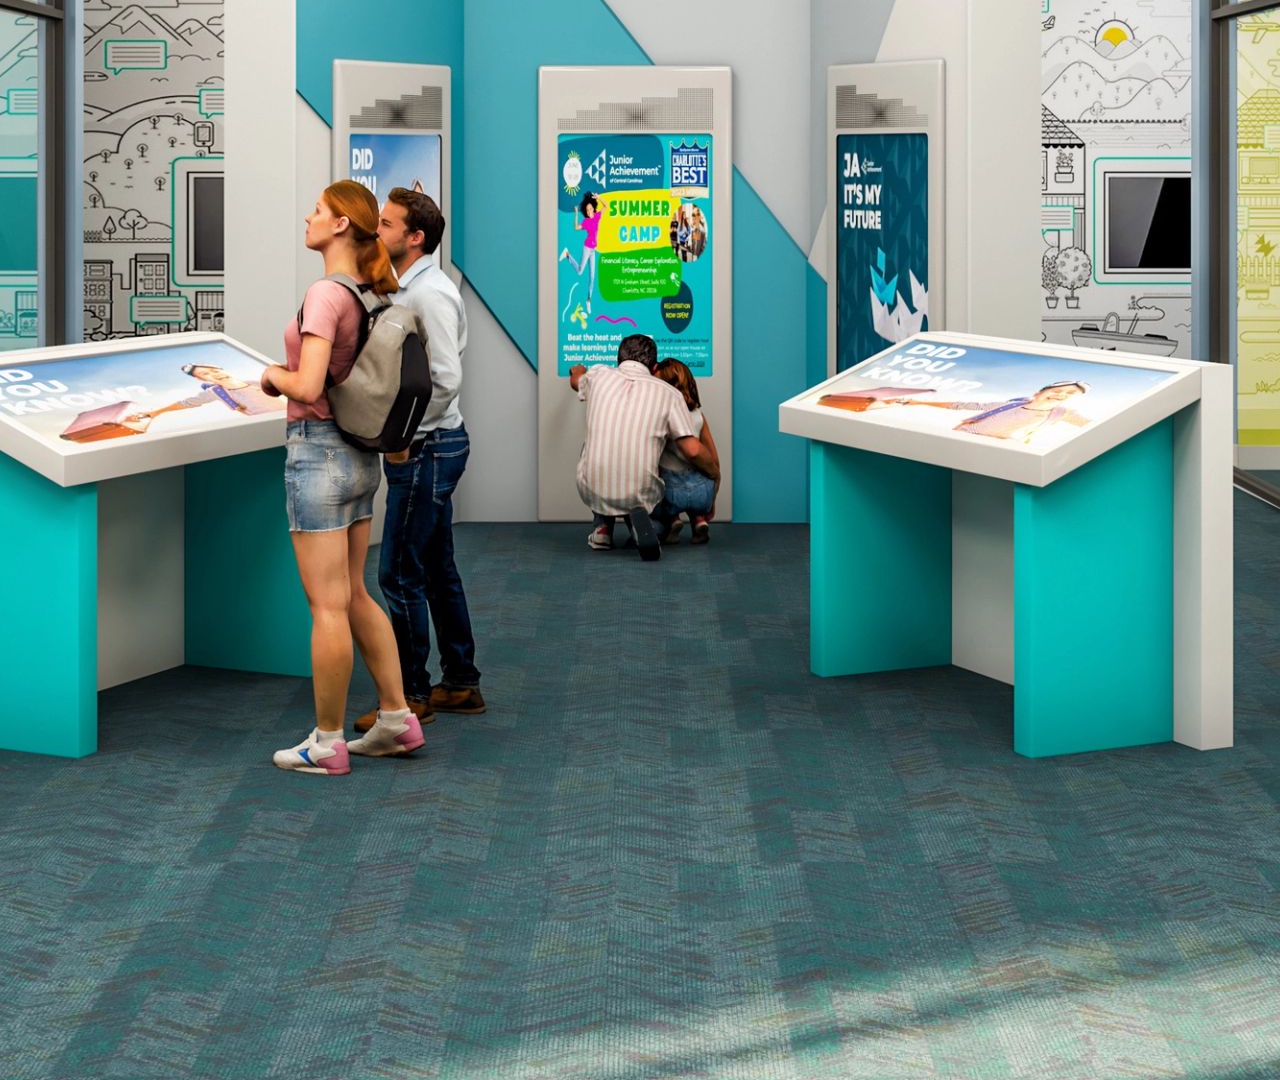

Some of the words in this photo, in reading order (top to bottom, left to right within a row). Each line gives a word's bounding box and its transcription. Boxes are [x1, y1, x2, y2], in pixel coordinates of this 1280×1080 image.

[352, 148, 373, 170] DID
[609, 154, 634, 165] Junior
[672, 154, 707, 167] CHARLOTTE'S
[843, 152, 861, 178] JA
[672, 167, 707, 184] BEST
[844, 183, 863, 205] IT'S
[865, 184, 882, 205] MY
[609, 200, 670, 217] SUMMER
[844, 209, 882, 230] FUTURE
[619, 225, 661, 243] CAMP
[582, 344, 607, 352] learning
[906, 343, 967, 359] DID
[888, 355, 957, 373] YOU
[860, 367, 983, 393] KNOW?
[2, 385, 152, 416] KNOW?
